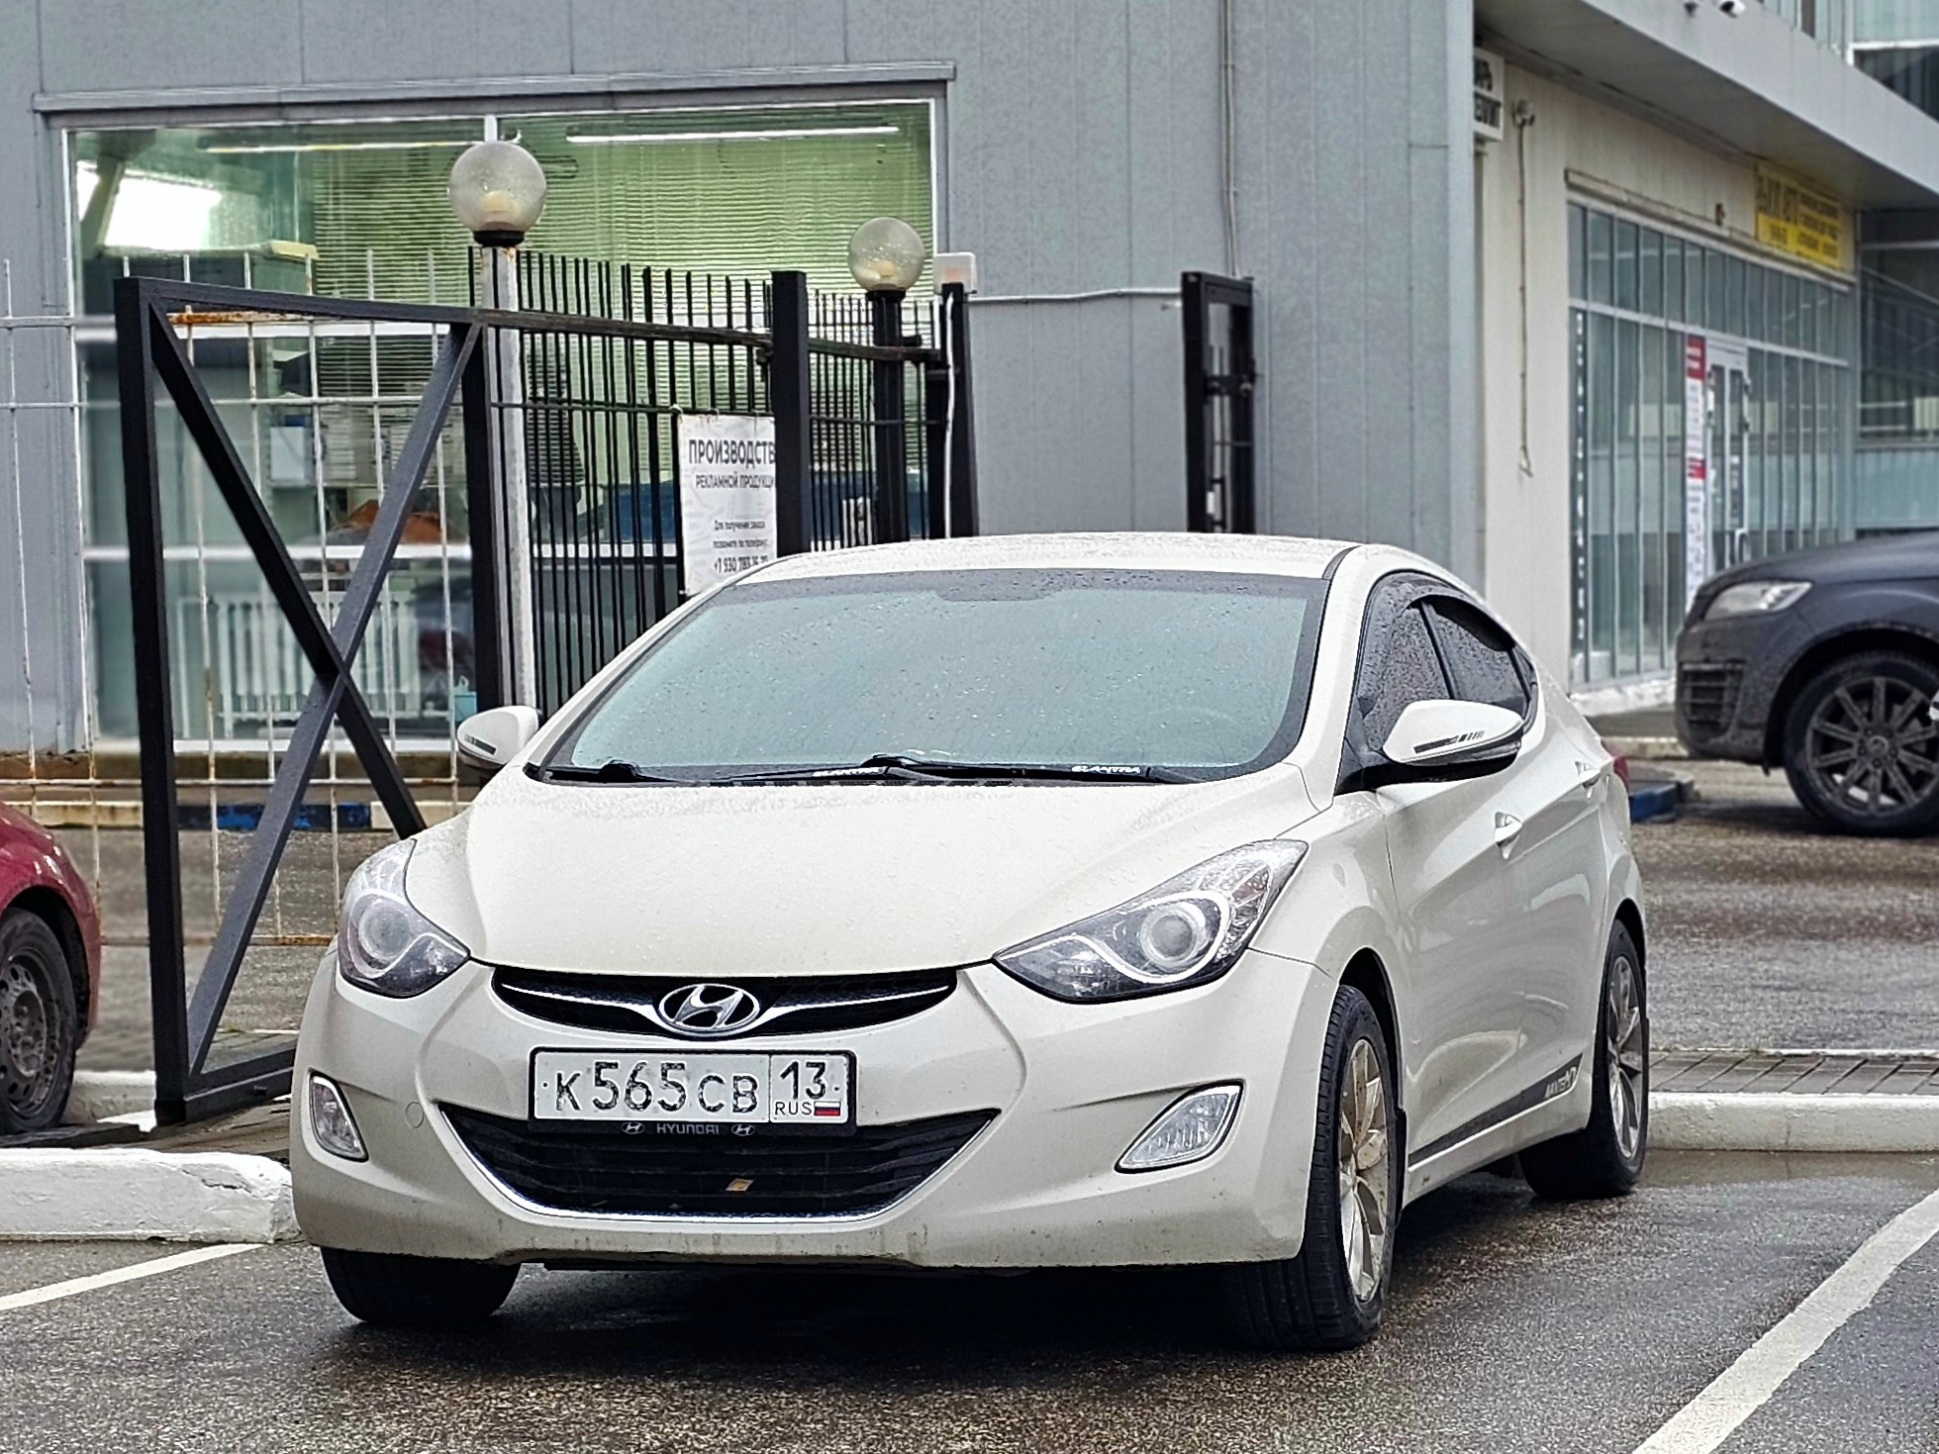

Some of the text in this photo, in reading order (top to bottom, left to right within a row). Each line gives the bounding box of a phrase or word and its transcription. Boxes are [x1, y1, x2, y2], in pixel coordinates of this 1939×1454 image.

[695, 471, 738, 488] РЕКЛАМНОЙ
[780, 1061, 827, 1100] 13
[775, 1102, 812, 1115] RUS
[657, 1123, 719, 1135] HYUNDAI
